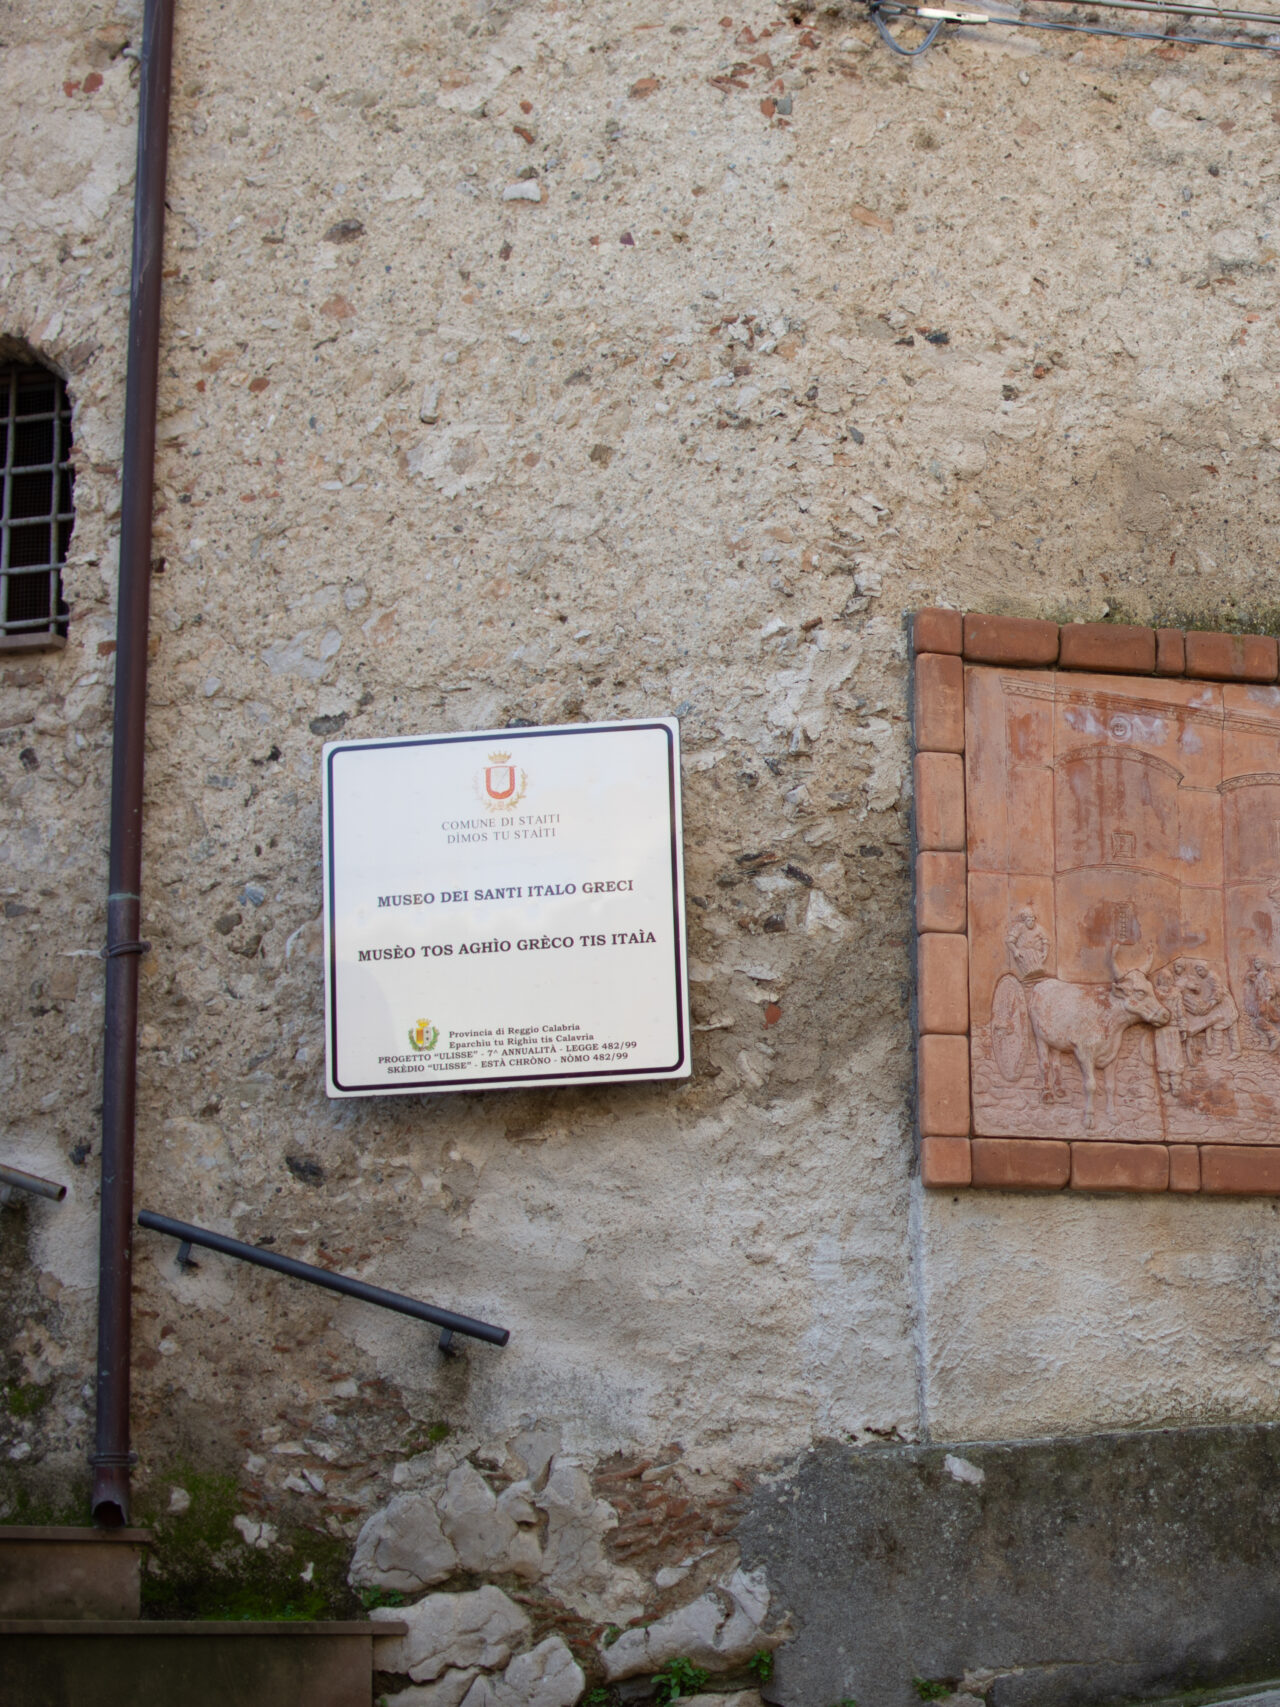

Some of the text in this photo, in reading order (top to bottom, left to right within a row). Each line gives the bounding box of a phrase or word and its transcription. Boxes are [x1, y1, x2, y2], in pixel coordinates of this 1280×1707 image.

[441, 814, 560, 831] COMUNE DI STAITI
[494, 831, 510, 841] TU
[377, 879, 634, 908] MUSEO DEI SANTI ITALO GRECI
[358, 929, 657, 962] MUSÈO TOS AGHÌO GRÈCO TIS ITAÌA
[449, 1023, 581, 1039] Provincia di Reggio Calabria
[449, 1032, 595, 1051] Eparchiu tu Righiu tis Calavria
[378, 1053, 431, 1065] PROGETTO
[502, 1044, 557, 1057] ANNUALITÀ
[566, 1042, 599, 1052] LEGGE
[601, 1040, 637, 1052] 482/99
[387, 1063, 425, 1075] SKÈDIO
[481, 1057, 506, 1069] ESTÀ
[509, 1055, 552, 1067] CHRÒNO
[560, 1052, 590, 1064] NÒMO
[592, 1051, 629, 1062] 482/99
